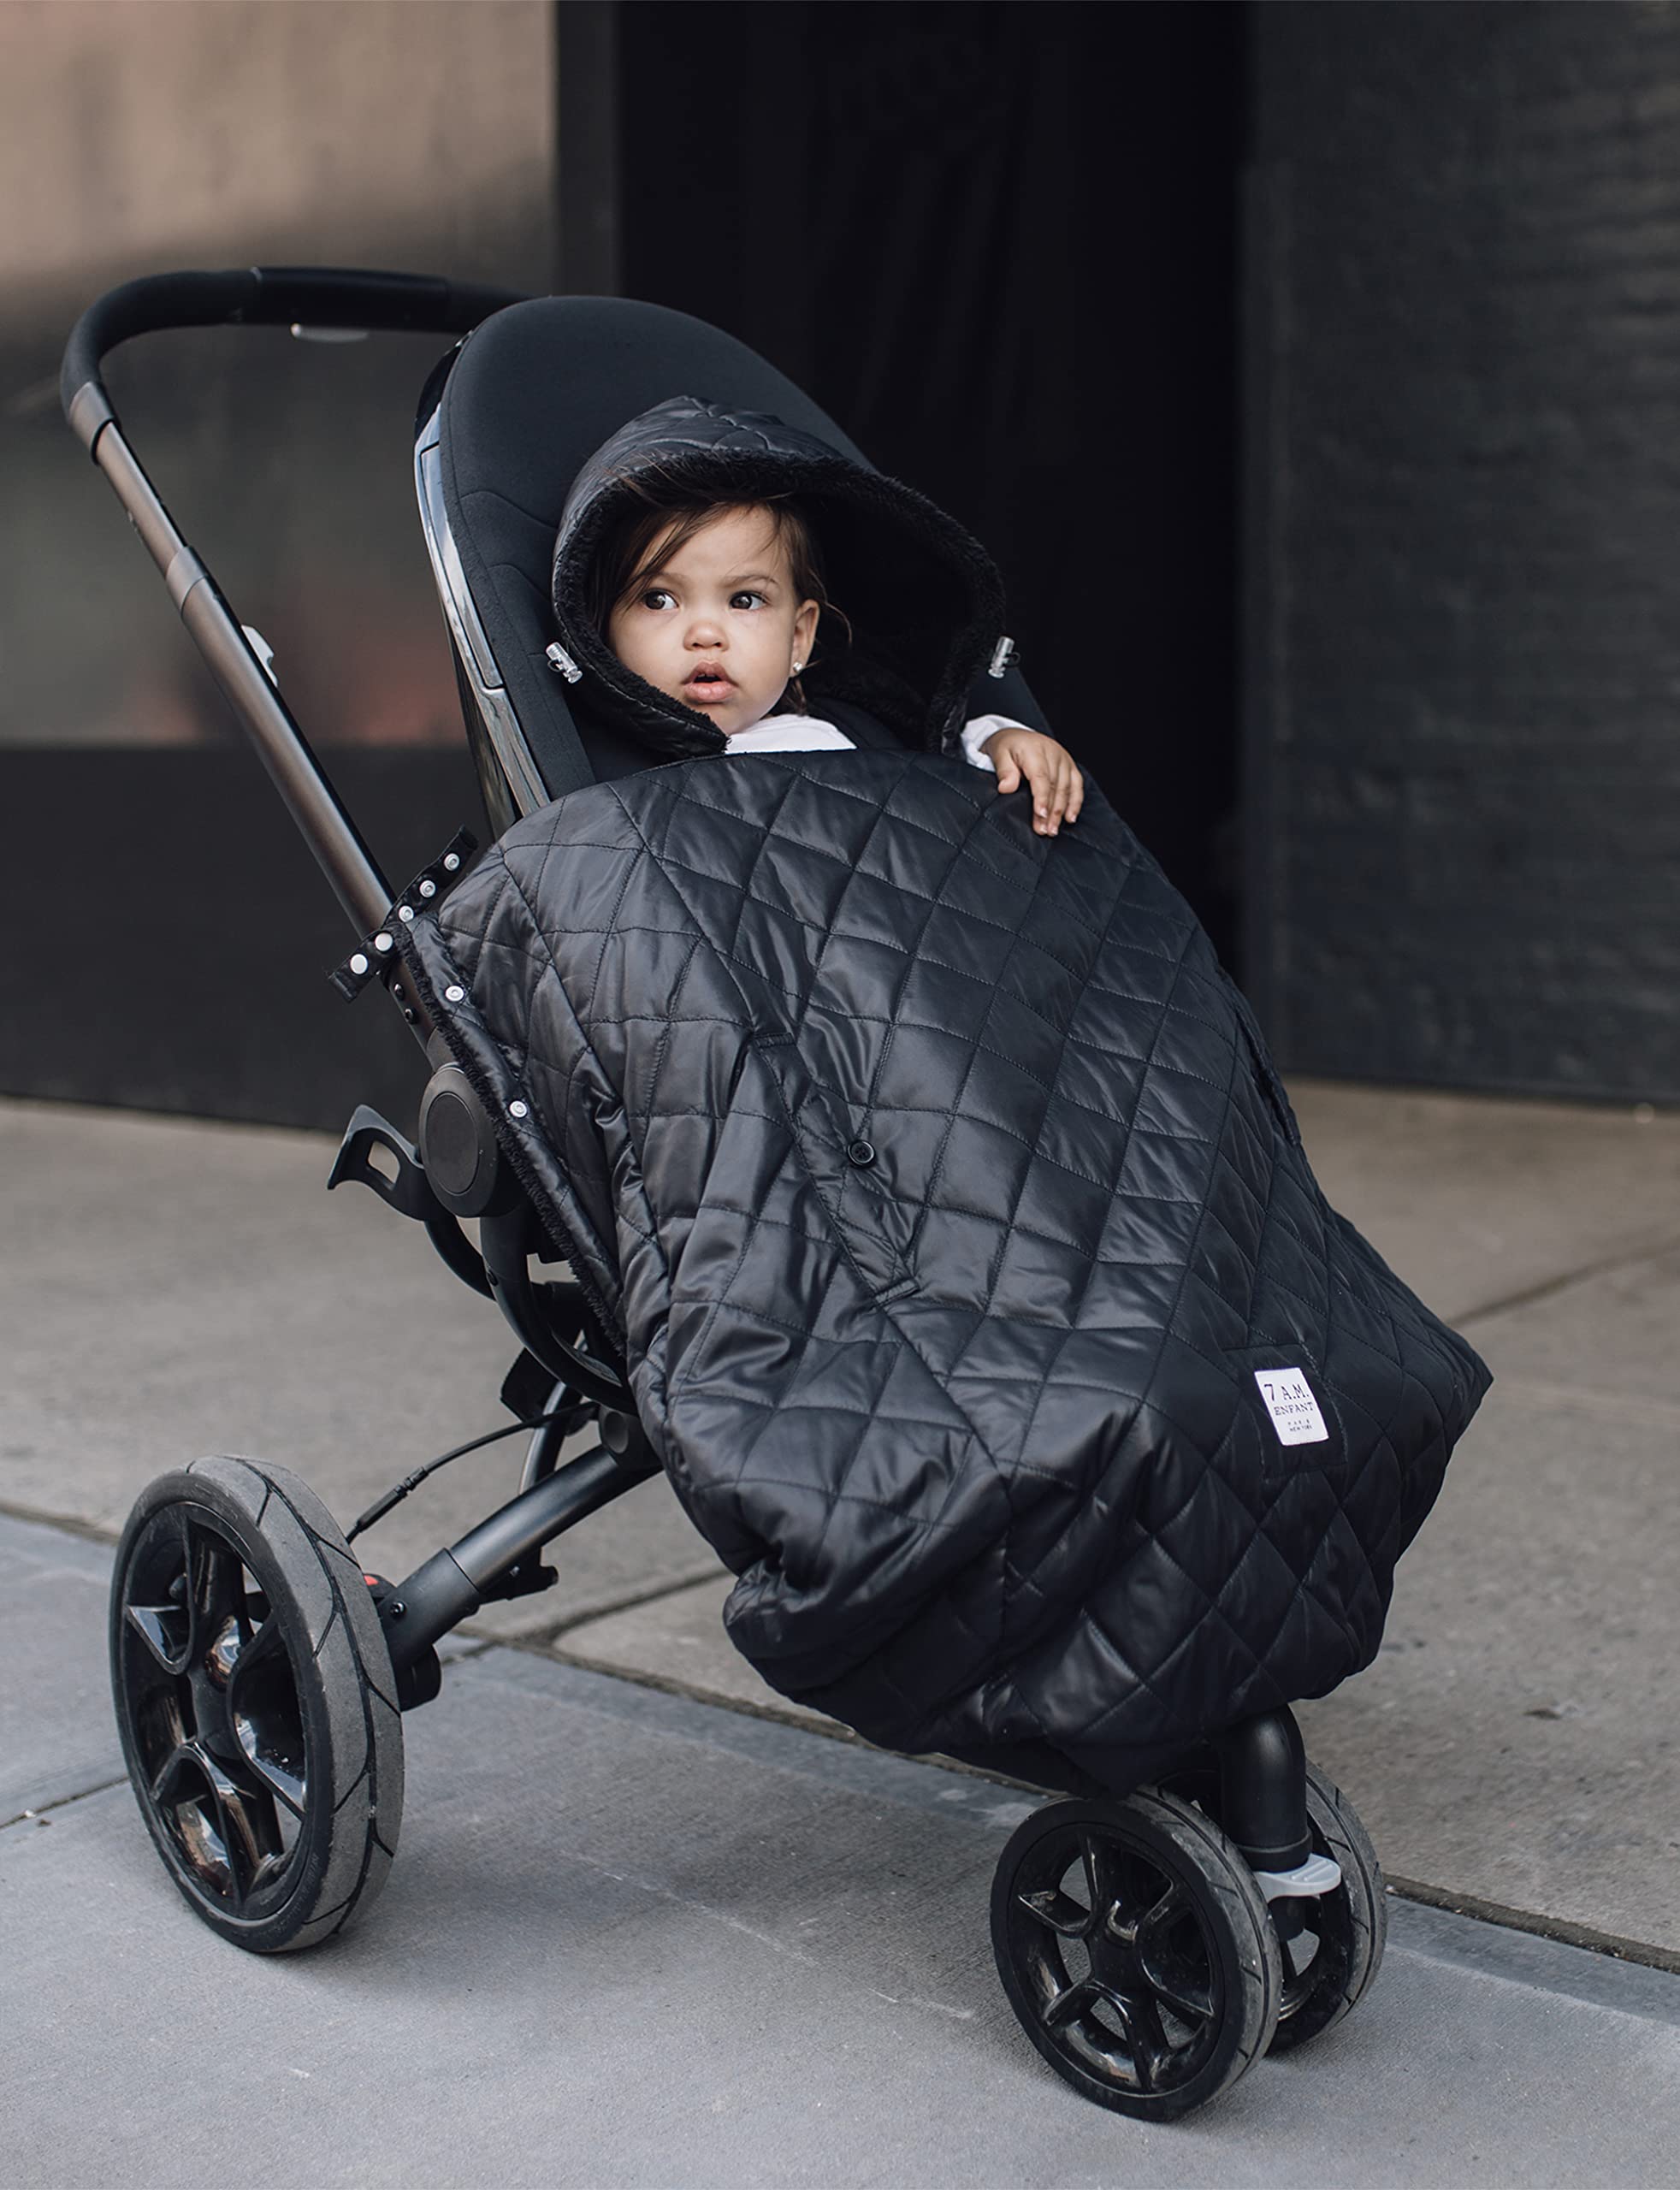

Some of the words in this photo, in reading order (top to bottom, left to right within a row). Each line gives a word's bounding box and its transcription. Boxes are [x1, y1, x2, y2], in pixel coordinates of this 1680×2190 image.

[1263, 1383, 1275, 1401] 7
[1281, 1383, 1310, 1400] A.M.
[1274, 1402, 1313, 1416] ENFANT
